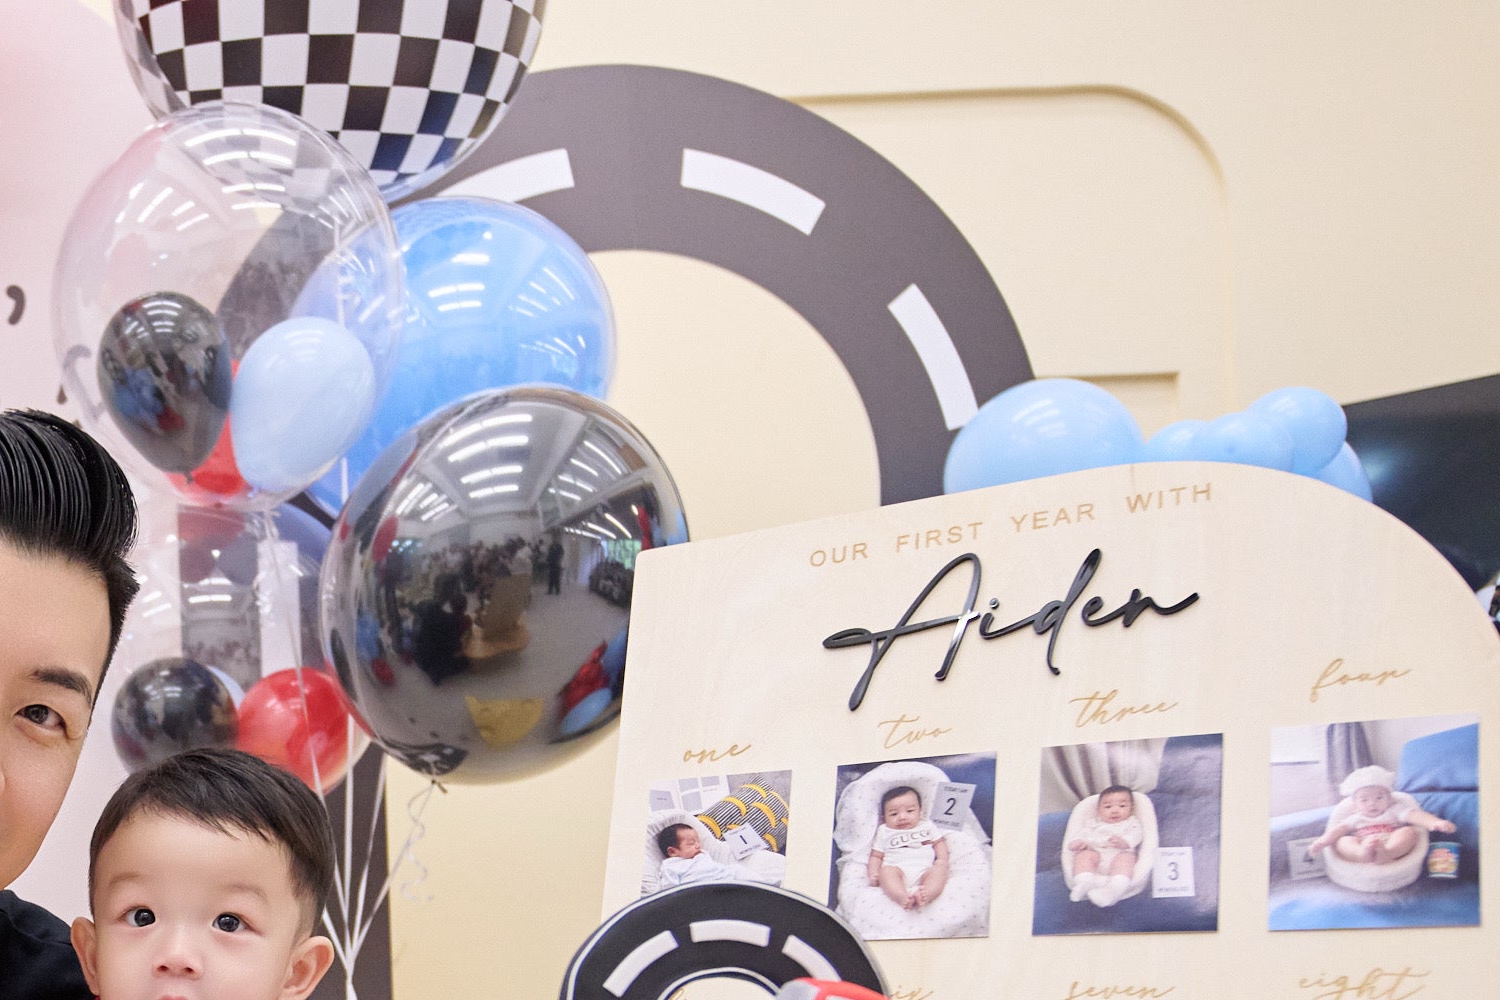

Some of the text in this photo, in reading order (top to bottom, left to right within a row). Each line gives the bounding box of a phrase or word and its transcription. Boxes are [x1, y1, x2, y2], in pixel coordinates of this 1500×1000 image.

[810, 482, 1213, 568] OUR FIRST YEAR WITH
[822, 548, 1200, 711] Aiden
[1309, 658, 1413, 703] four
[1068, 689, 1179, 727] three
[877, 714, 953, 748] two
[682, 744, 752, 763] one
[943, 797, 957, 816] 2
[1167, 861, 1180, 880] 3
